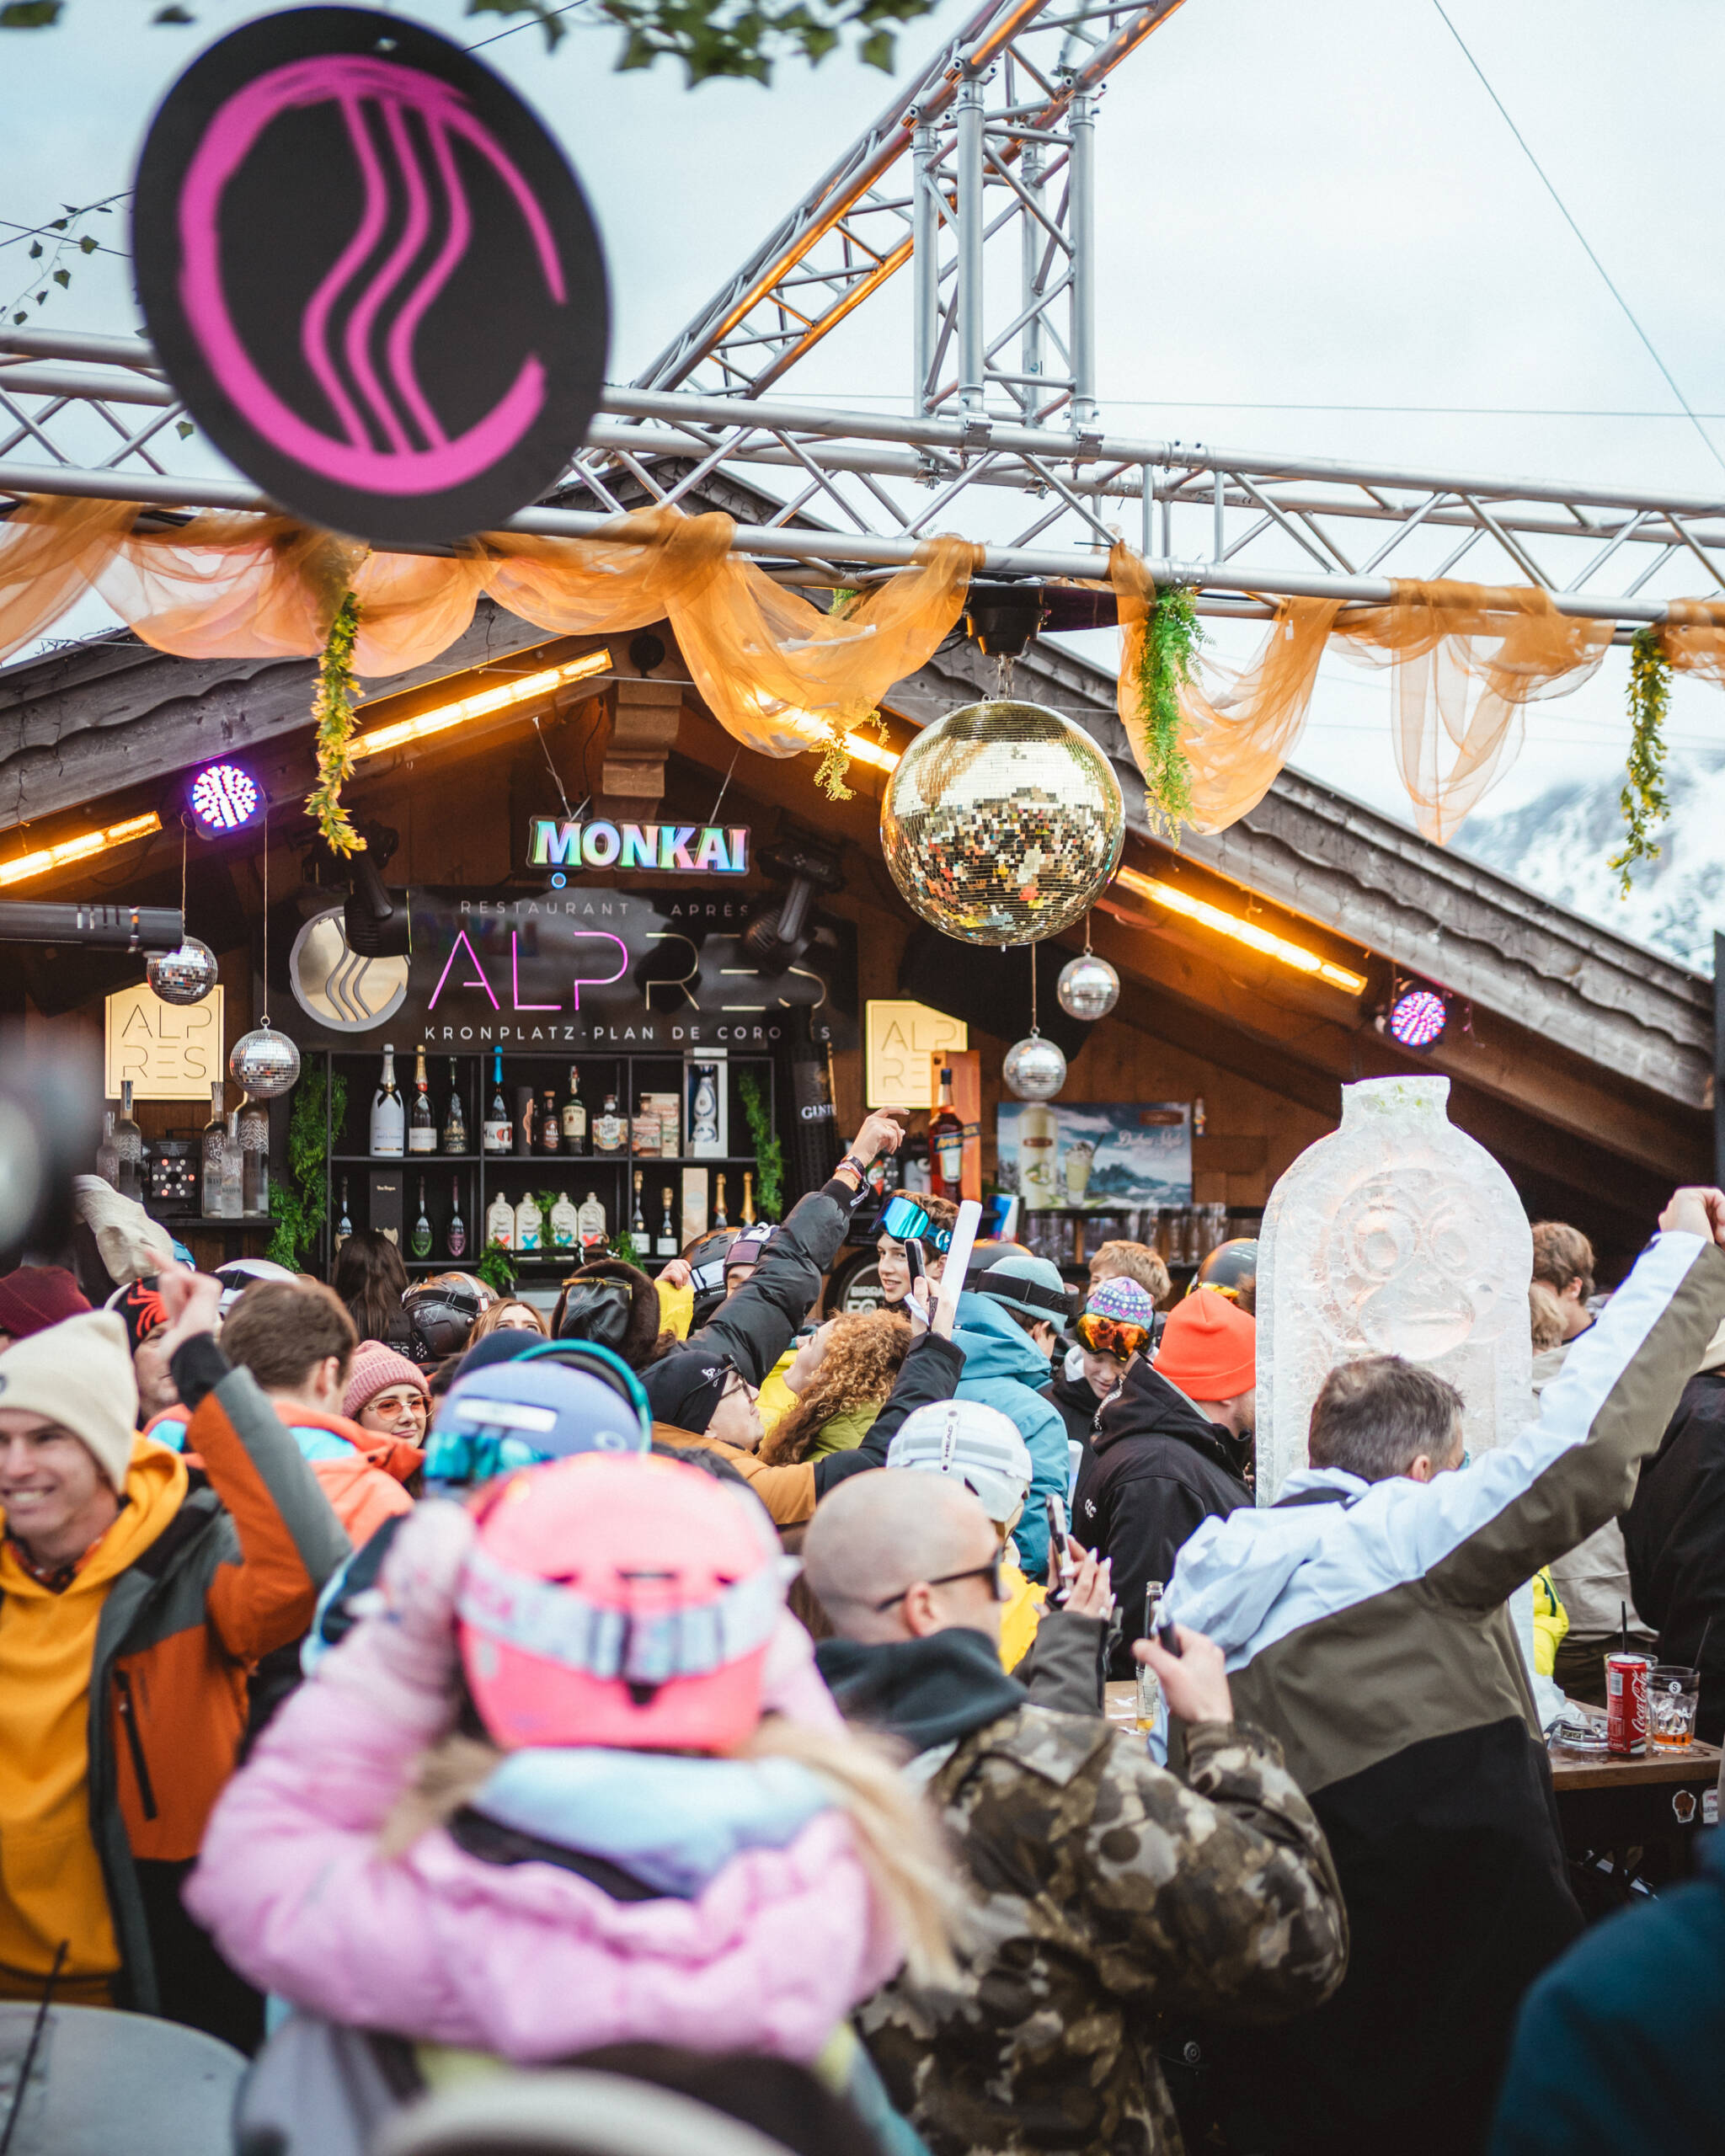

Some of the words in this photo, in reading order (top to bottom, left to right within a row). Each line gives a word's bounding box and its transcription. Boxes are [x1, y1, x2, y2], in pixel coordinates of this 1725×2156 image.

[533, 820, 746, 872] MONKAI
[460, 900, 629, 915] RESTAURANT
[121, 1004, 212, 1038] ALP
[425, 1026, 654, 1041] KRONPLATZ-PLAN
[671, 1026, 701, 1041] DE
[881, 1020, 958, 1052] ALP
[123, 1044, 207, 1080] RES
[883, 1057, 929, 1088] RE
[850, 1286, 885, 1298] BIRRA
[944, 1424, 953, 1458] HEAD
